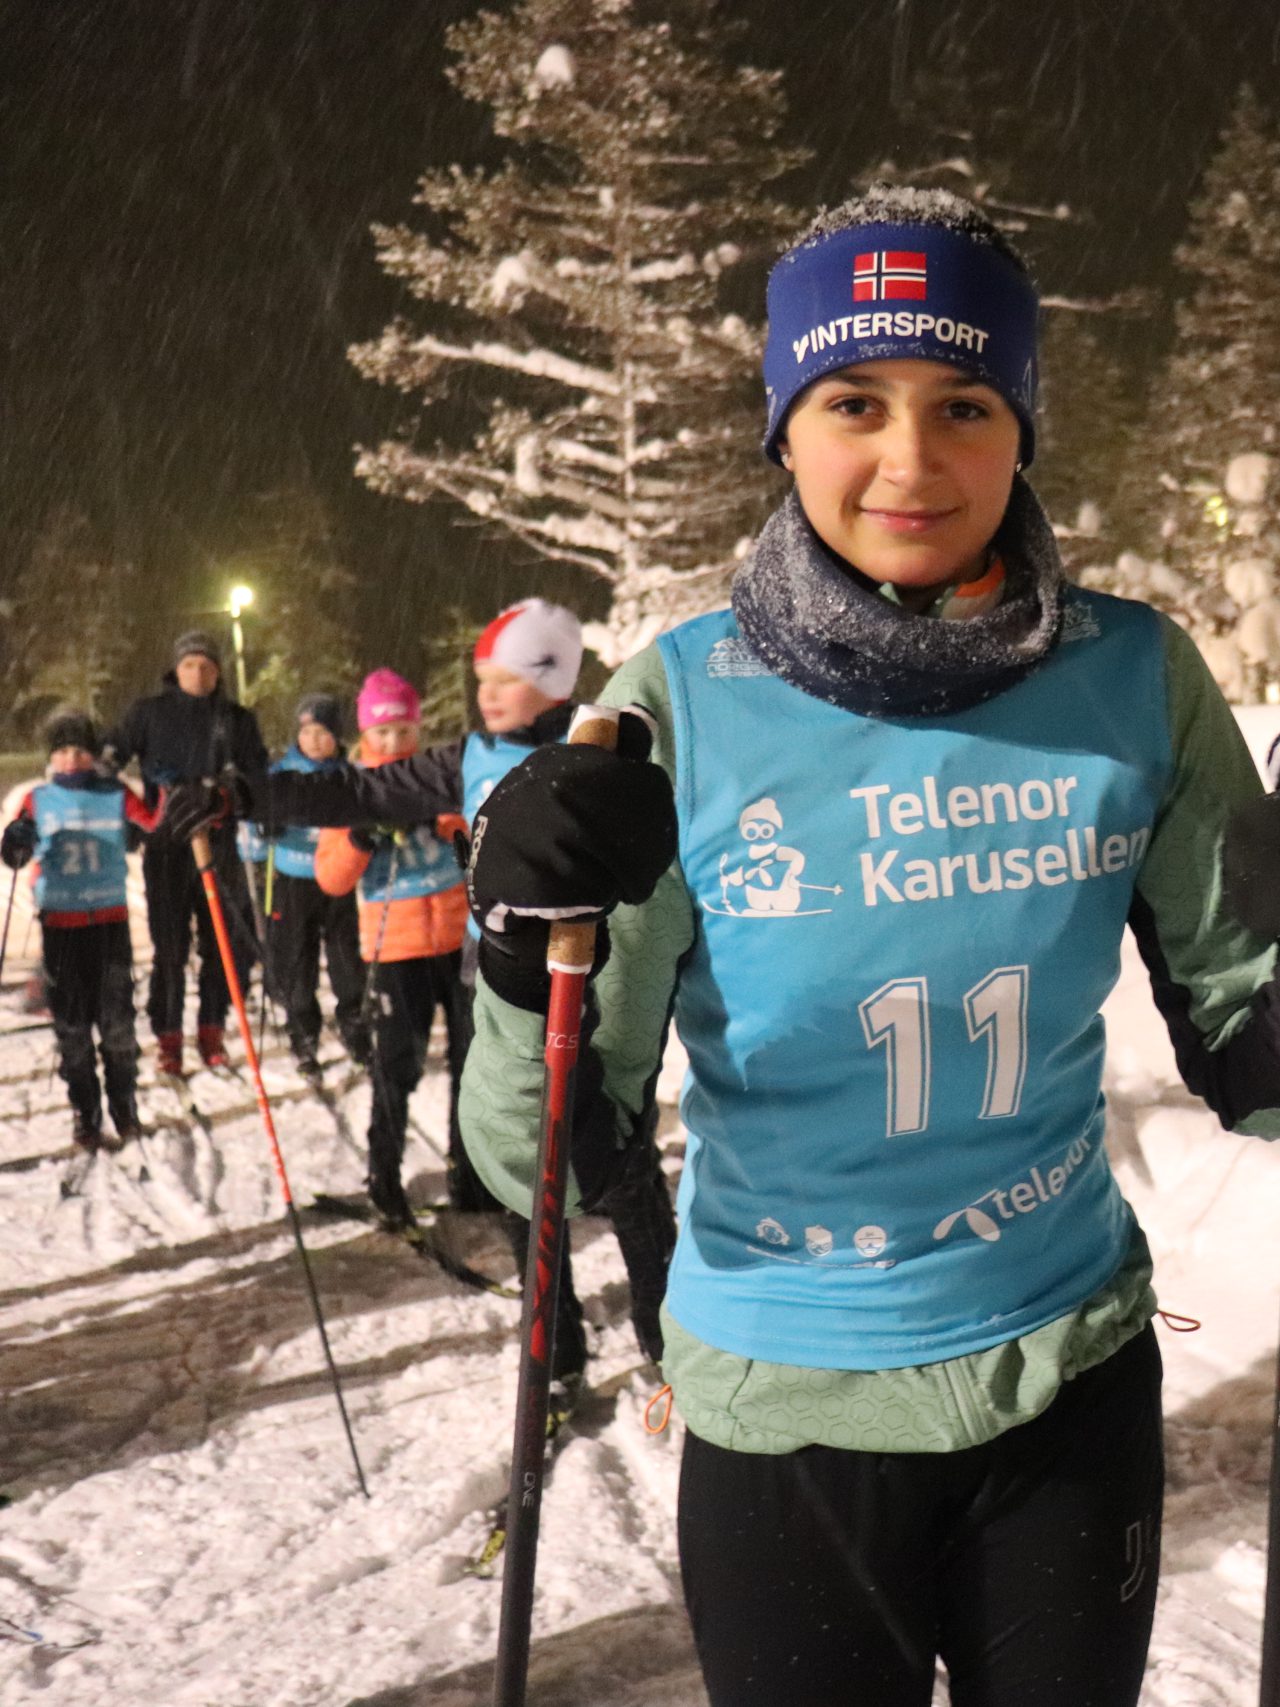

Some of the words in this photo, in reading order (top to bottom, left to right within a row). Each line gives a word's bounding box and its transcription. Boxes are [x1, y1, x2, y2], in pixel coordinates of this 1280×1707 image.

[811, 311, 989, 354] INTERSPORT
[849, 775, 1078, 838] Telenor
[62, 840, 100, 875] 21
[859, 825, 1150, 907] Karusellen
[857, 964, 1030, 1138] 11
